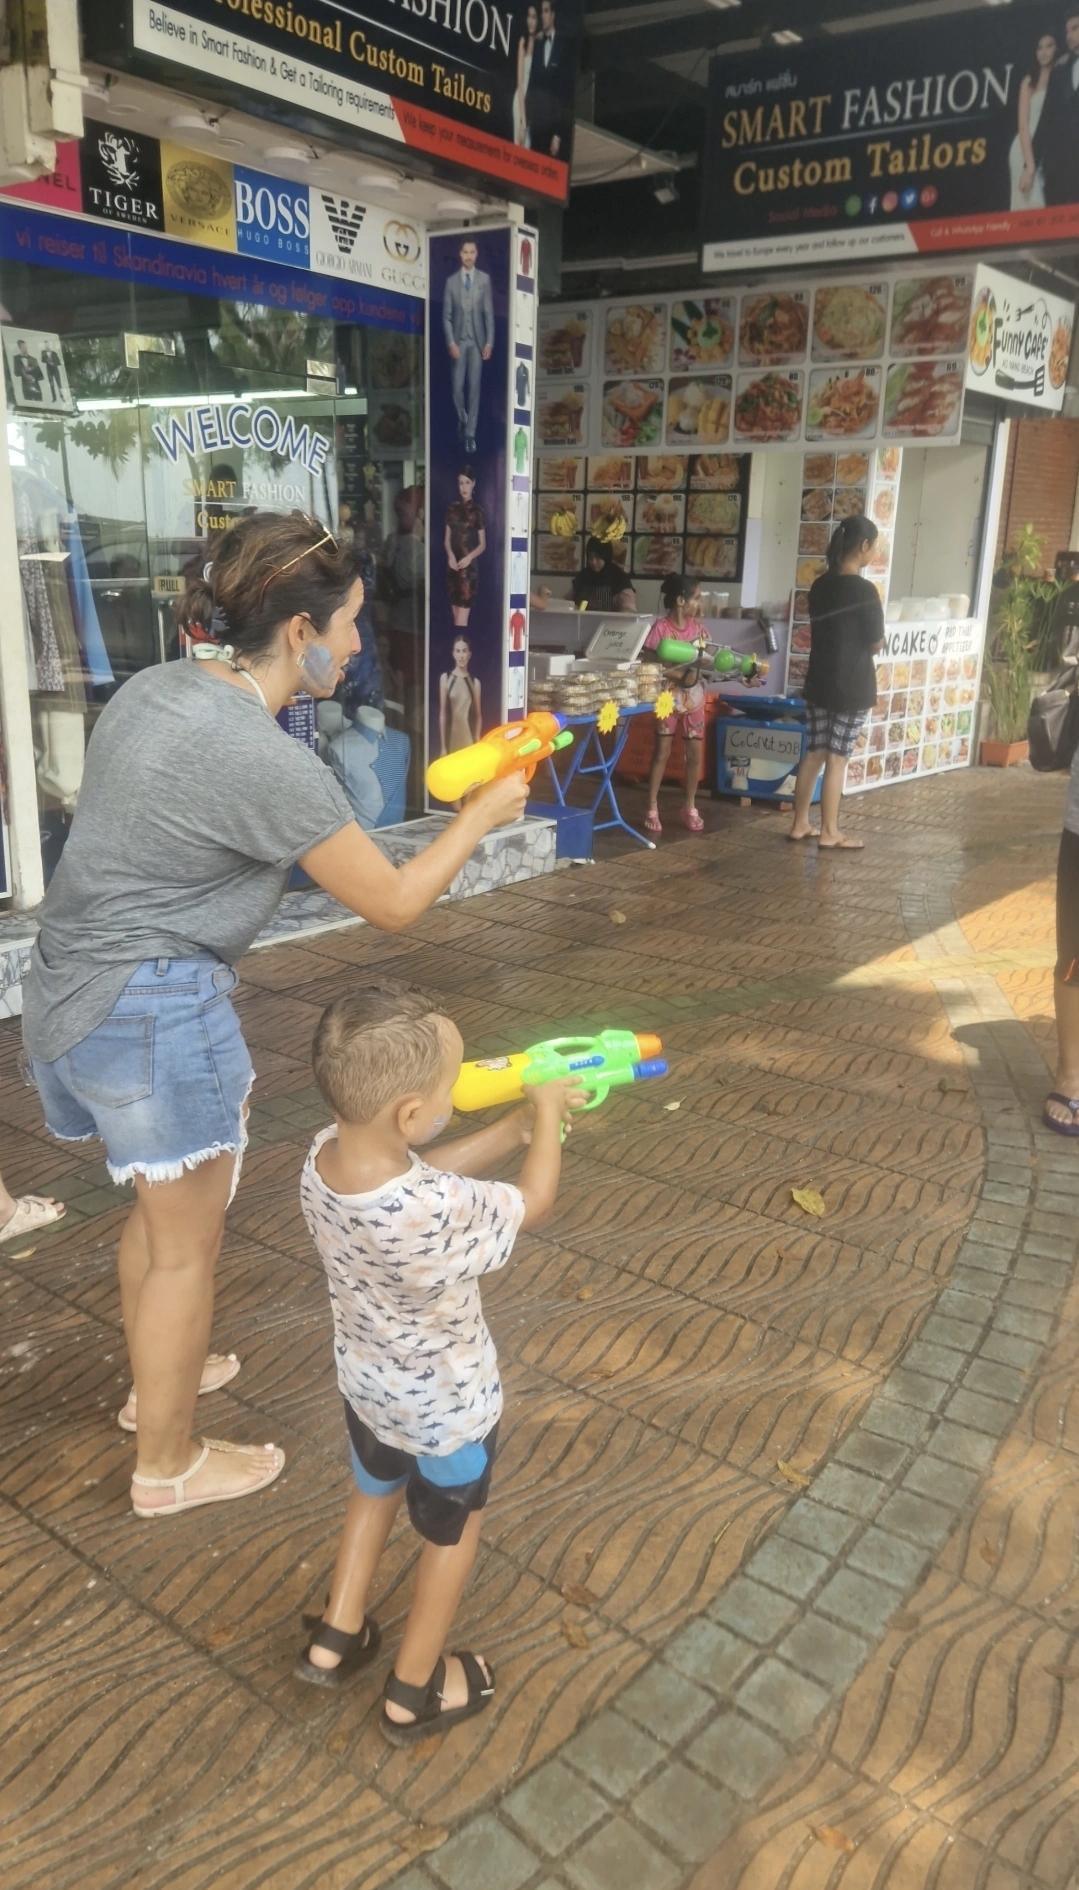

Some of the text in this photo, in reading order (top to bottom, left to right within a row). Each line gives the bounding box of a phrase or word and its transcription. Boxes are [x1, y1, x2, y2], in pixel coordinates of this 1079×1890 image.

[149, 9, 395, 120] Believe in Smart Fashion & Get a Tailoring requirements
[349, 31, 425, 86] Custom
[431, 63, 491, 113] Tailors
[722, 64, 1014, 148] SMART FASHION
[733, 133, 987, 194] Custom Tailors
[89, 187, 158, 219] TIGER
[235, 180, 311, 239] BOSS
[238, 228, 309, 255] HUGO BOSS
[152, 403, 330, 476] WELCOME
[183, 479, 306, 501] SMART FASHION
[159, 577, 180, 592] PULL
